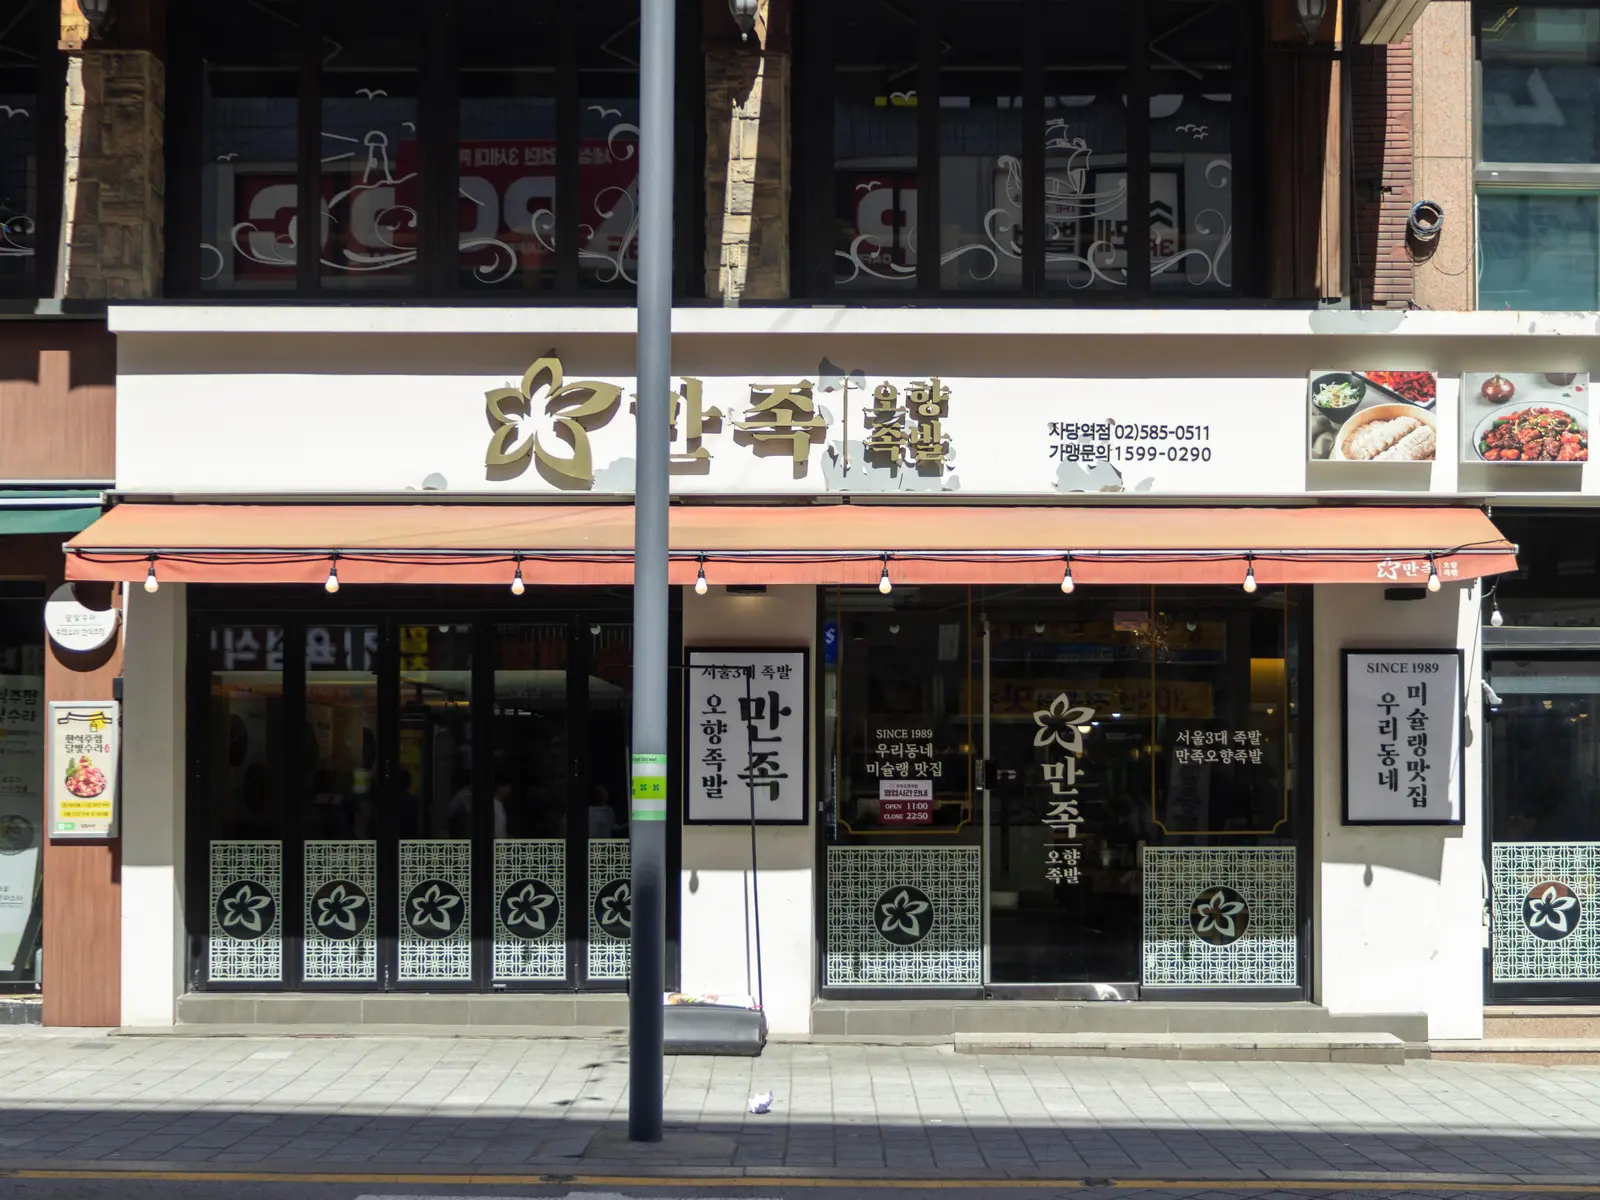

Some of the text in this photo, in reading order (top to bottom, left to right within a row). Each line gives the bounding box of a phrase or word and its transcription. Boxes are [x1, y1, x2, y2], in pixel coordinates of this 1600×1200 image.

[863, 377, 951, 416] 오향
[1114, 423, 1209, 441] 02)585-0511
[863, 420, 951, 462] 족발
[1049, 443, 1211, 462] 가맹문의 1599-0290
[760, 664, 793, 680] 족발
[1366, 662, 1439, 674] SINCE 1989
[876, 729, 933, 739] SINCE 1989
[1176, 729, 1262, 746] 서울3대 족발
[1376, 691, 1400, 793] 우리동네
[700, 693, 728, 799] 오향족발
[736, 690, 792, 802] 만족
[875, 743, 933, 759] 우리동네
[1175, 748, 1263, 765] 만족오향족발
[866, 761, 942, 777] 미슐랭 맛집
[884, 789, 928, 797] 영업시간 안내
[1041, 755, 1085, 839] 만족
[906, 802, 928, 810] 11:00
[906, 812, 928, 820] 22:50
[1045, 848, 1081, 865] 오향
[1045, 867, 1081, 884] 족발
